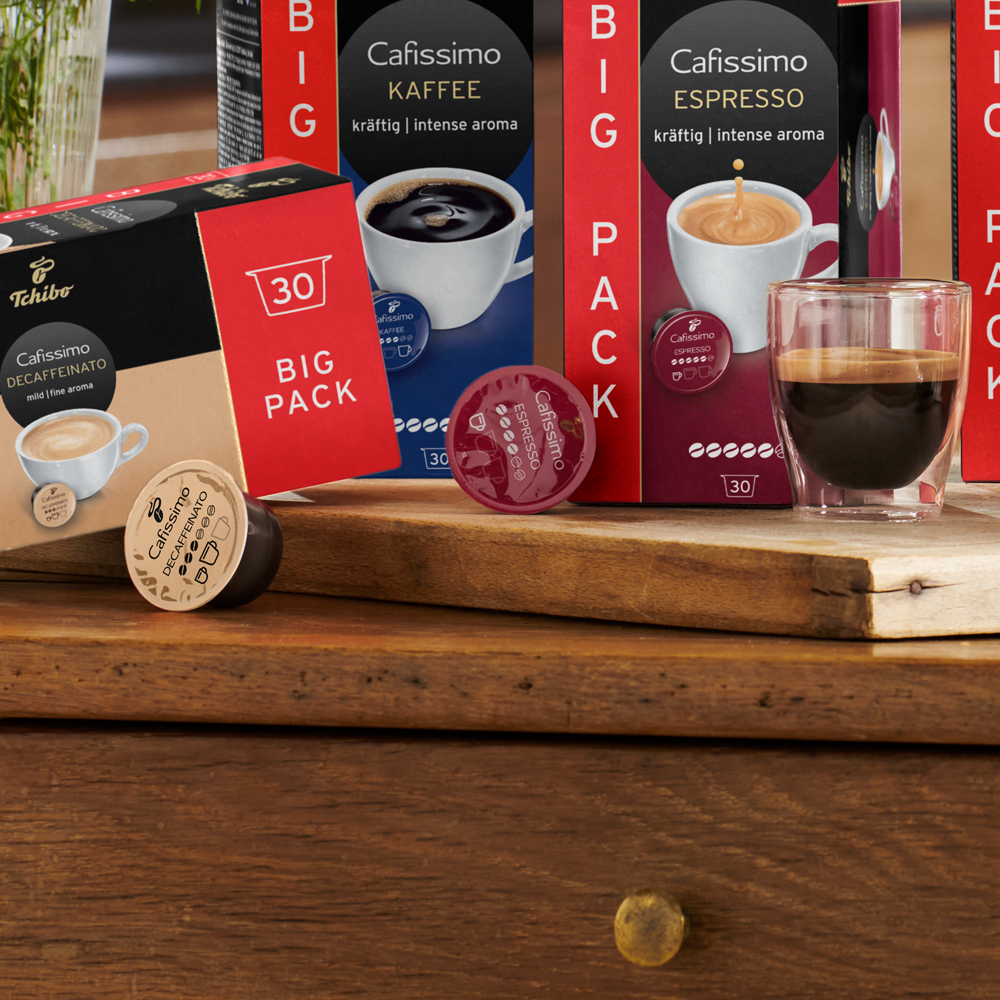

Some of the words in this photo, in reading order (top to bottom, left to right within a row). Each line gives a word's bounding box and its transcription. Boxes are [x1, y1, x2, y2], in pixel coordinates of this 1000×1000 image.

[367, 41, 501, 66] Cafissimo
[670, 47, 808, 74] Cafissimo
[590, 5, 617, 148] BIG
[389, 80, 481, 99] KAFFEE
[674, 88, 804, 109] ESPRESSO
[352, 118, 401, 134] kräftig
[414, 118, 468, 132] intense
[472, 119, 518, 131] aroma
[654, 128, 703, 144] kräftig
[717, 128, 772, 142] intense
[777, 129, 825, 141] aroma
[9, 283, 74, 308] Tchibo
[270, 272, 314, 305] 30
[376, 313, 414, 324] afissimo
[590, 222, 619, 418] PACK
[670, 331, 715, 343] Cafissimo
[16, 344, 90, 367] Cafissimo
[674, 345, 711, 355] ESPRESSO
[6, 358, 107, 388] DECAFFEINATO
[276, 350, 335, 384] BIG
[26, 390, 44, 402] mild
[50, 387, 66, 397] fine
[67, 382, 94, 394] aroma
[264, 378, 357, 419] PACK
[514, 403, 541, 470] ESPRESSO
[535, 390, 565, 470] Cafissimo
[430, 453, 449, 466] 30
[729, 480, 750, 494] 30
[148, 486, 190, 560] Cafissimo
[162, 490, 208, 577] DECAFFEINATO
